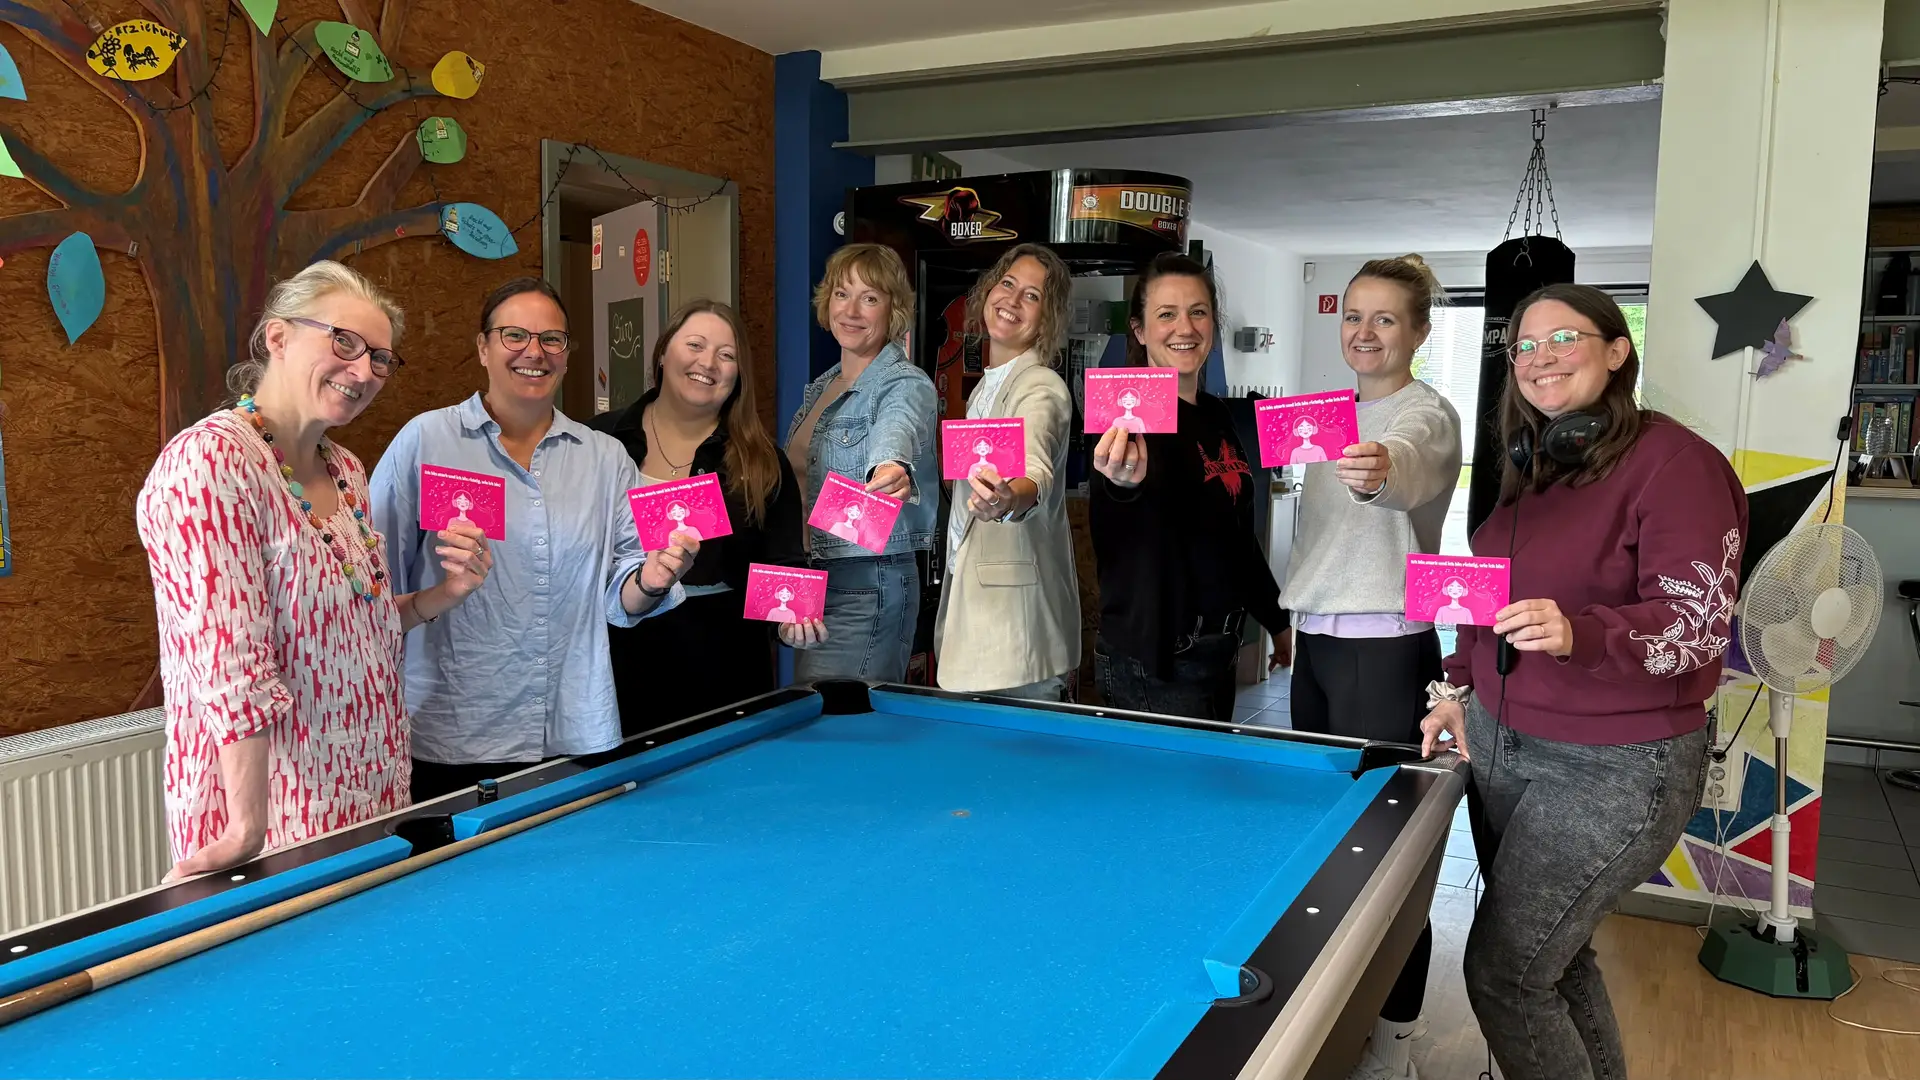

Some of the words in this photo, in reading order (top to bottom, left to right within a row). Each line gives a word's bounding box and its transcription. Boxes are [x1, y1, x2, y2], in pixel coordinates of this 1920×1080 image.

[1120, 190, 1184, 217] DOUBLE
[950, 221, 982, 237] BOXER
[1157, 220, 1177, 231] BOXER
